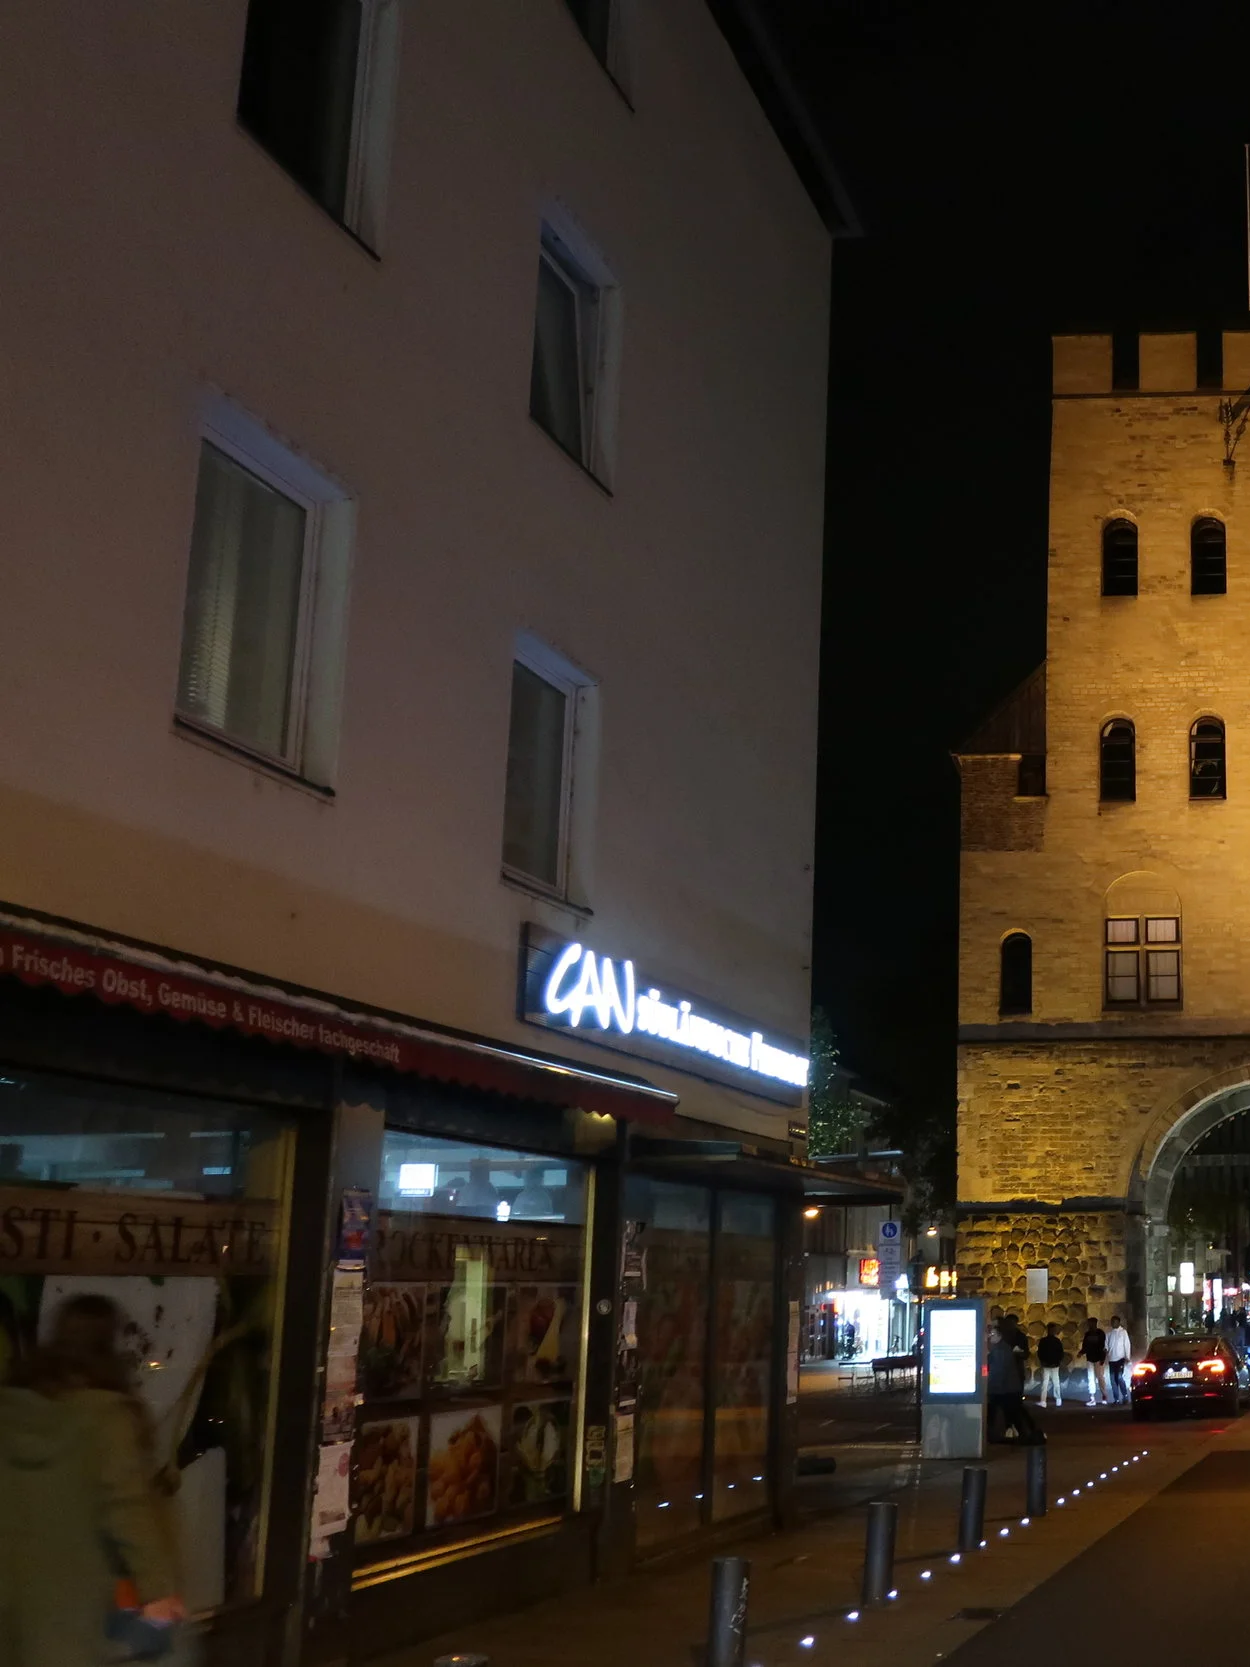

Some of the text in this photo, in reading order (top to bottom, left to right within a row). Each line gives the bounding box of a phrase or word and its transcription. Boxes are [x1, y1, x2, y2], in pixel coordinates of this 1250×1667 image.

[12, 944, 96, 988] Frisches
[102, 967, 153, 1005] Obst,
[157, 981, 227, 1018] Gemüse
[231, 999, 245, 1022] &
[248, 1004, 315, 1041] Fleischer
[546, 943, 636, 1034] CAN
[115, 1212, 266, 1266] SALATE
